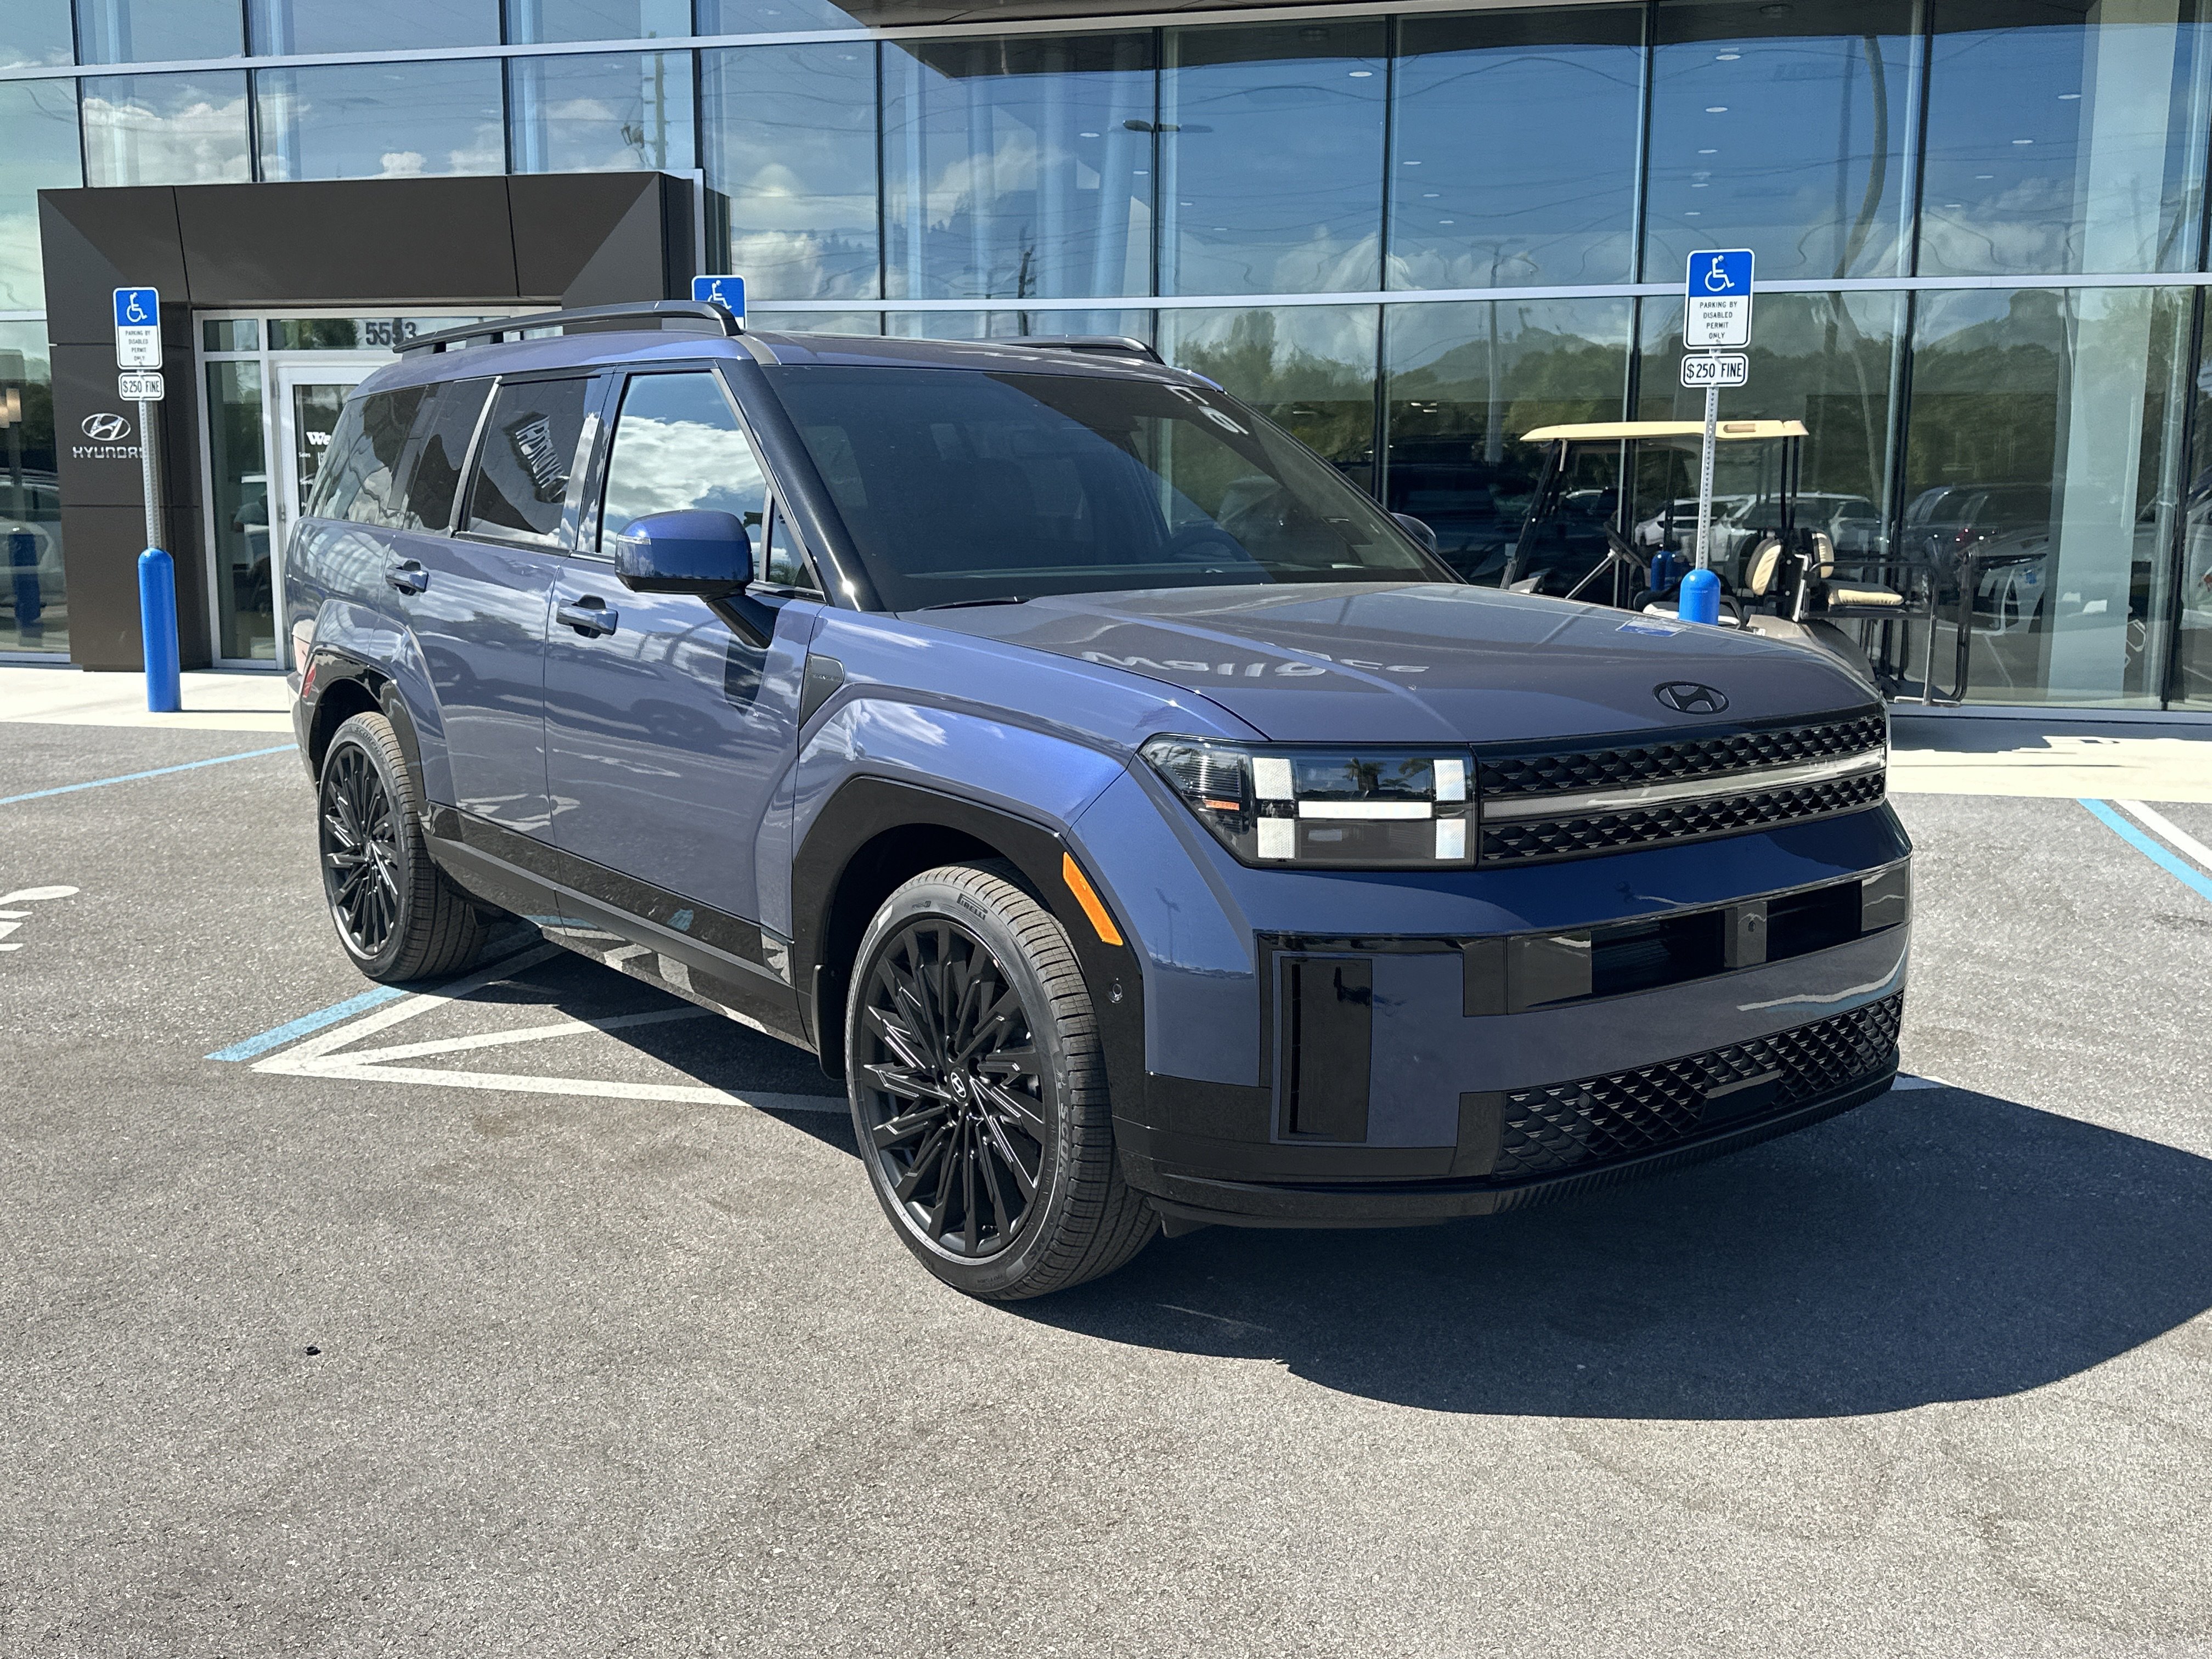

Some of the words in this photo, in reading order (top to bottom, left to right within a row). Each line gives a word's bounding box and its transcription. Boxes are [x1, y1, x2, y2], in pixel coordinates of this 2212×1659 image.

[1686, 362, 1716, 380] $250
[1721, 363, 1742, 377] FINE
[122, 380, 142, 393] $250
[145, 380, 160, 393] FINE
[72, 446, 142, 459] HYUNDAI
[957, 893, 988, 921] PIRELLI
